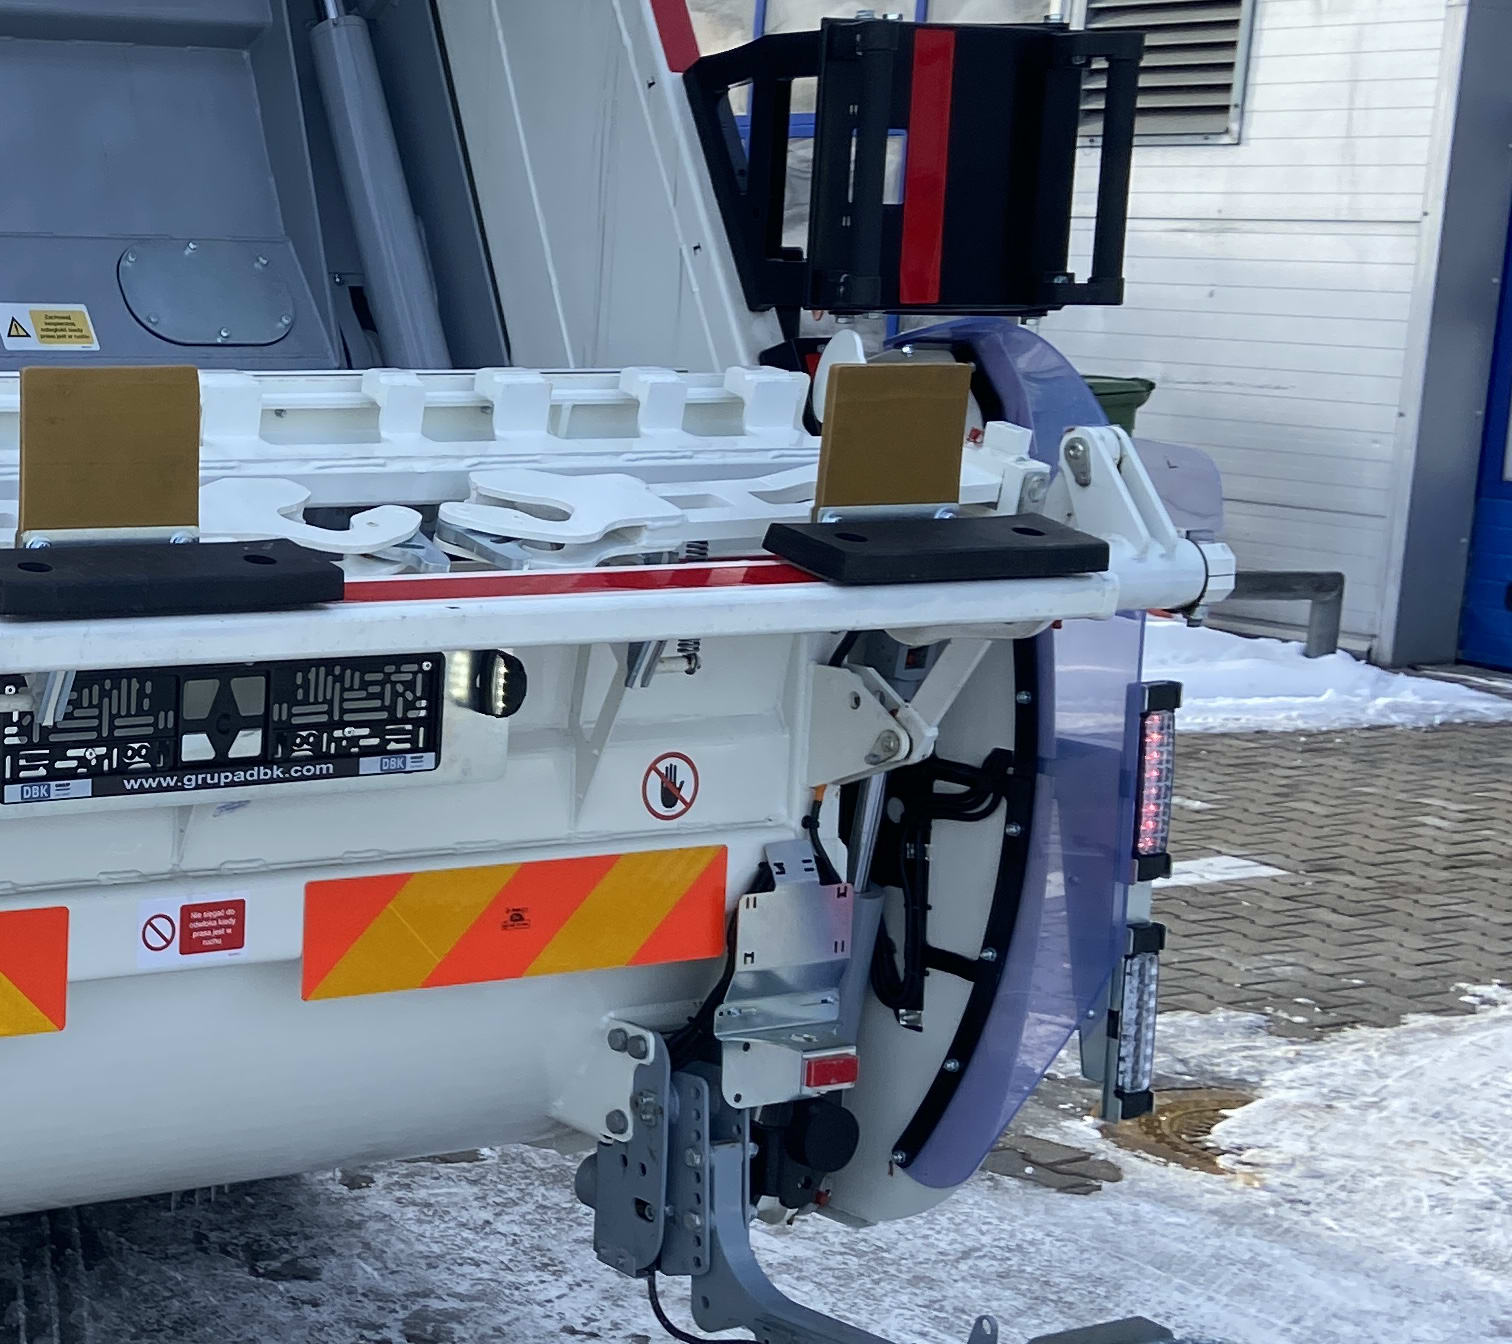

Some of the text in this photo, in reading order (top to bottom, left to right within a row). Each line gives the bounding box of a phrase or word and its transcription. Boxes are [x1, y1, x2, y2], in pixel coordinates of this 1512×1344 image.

[382, 756, 405, 770] DBK
[123, 762, 334, 790] www.grupadbk.com
[23, 785, 49, 798] DBK
[225, 908, 236, 916] do
[218, 917, 236, 926] kiedy
[192, 930, 211, 939] prasa
[212, 928, 225, 936] jest
